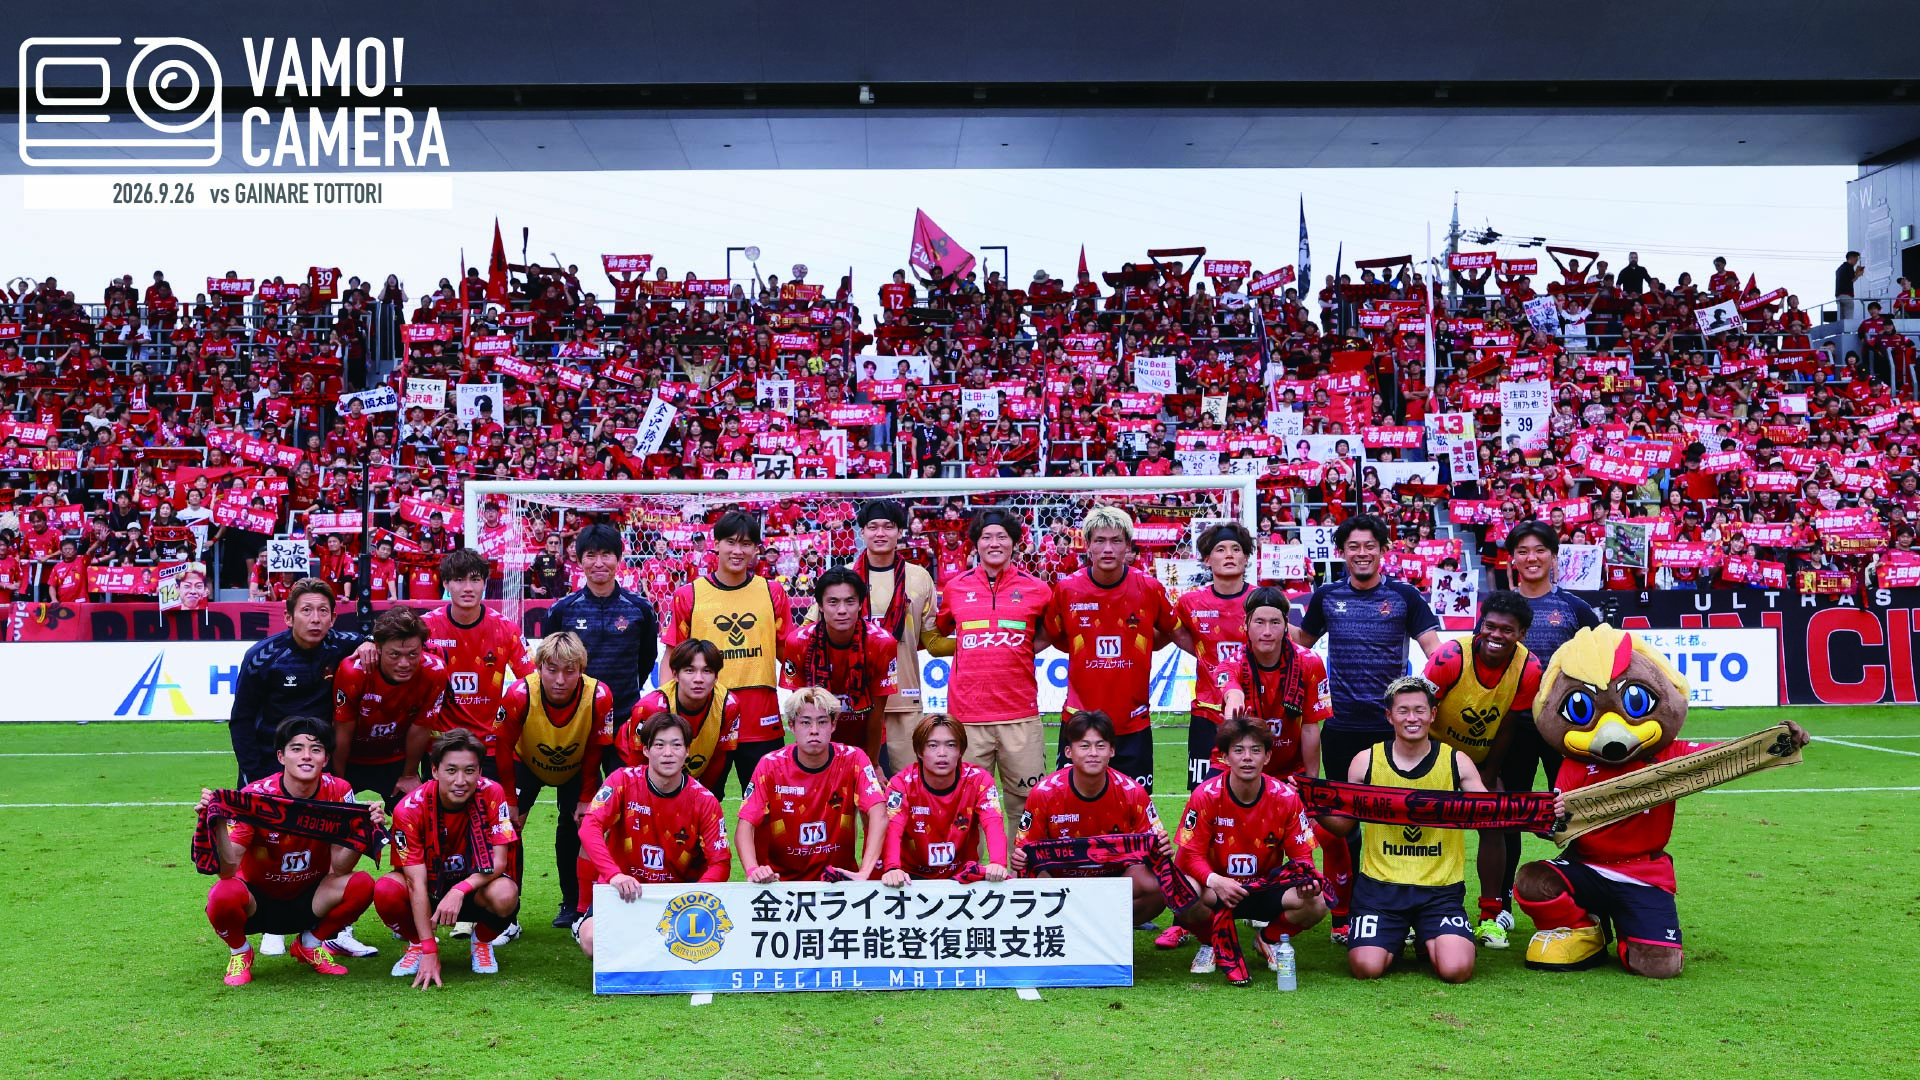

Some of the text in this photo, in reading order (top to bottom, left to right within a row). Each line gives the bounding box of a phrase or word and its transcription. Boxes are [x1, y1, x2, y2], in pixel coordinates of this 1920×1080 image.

[318, 272, 333, 286] 39
[889, 294, 904, 309] 12
[1774, 356, 1803, 365] Zweigen
[1164, 379, 1171, 389] 9
[1509, 390, 1542, 399] 庄司 39
[1434, 415, 1464, 434] 13
[1518, 417, 1533, 432] 39
[9, 426, 48, 441] 上田樹
[1367, 431, 1418, 443] 寺阪尚悟
[1630, 448, 1672, 462] 上田樹
[271, 543, 306, 556] やった
[1285, 565, 1300, 576] 16
[96, 573, 134, 586] 川上竜
[161, 585, 180, 604] 14
[962, 631, 1025, 649] @ネスク
[1100, 639, 1120, 656] STS
[1085, 660, 1133, 669] システムサポート
[453, 675, 476, 691] STS
[453, 695, 491, 705] テムサポート
[1353, 795, 1393, 810] WE ARE
[1352, 805, 1396, 819] ZWEIGEN
[802, 824, 825, 843] STS
[930, 846, 954, 865] STS
[1383, 841, 1442, 857] hummel
[284, 850, 311, 871] STS
[642, 847, 664, 868] STS
[1231, 856, 1256, 873] STS
[673, 894, 717, 909] LIONS
[751, 889, 1071, 921] 金沢ライオンズクラブ
[687, 914, 706, 937] L
[1354, 915, 1379, 939] 16
[674, 944, 717, 958] INTERNATIONAL
[752, 926, 1066, 961] 70周年能登復興支援
[732, 967, 988, 990] SPECIAL MATCH
